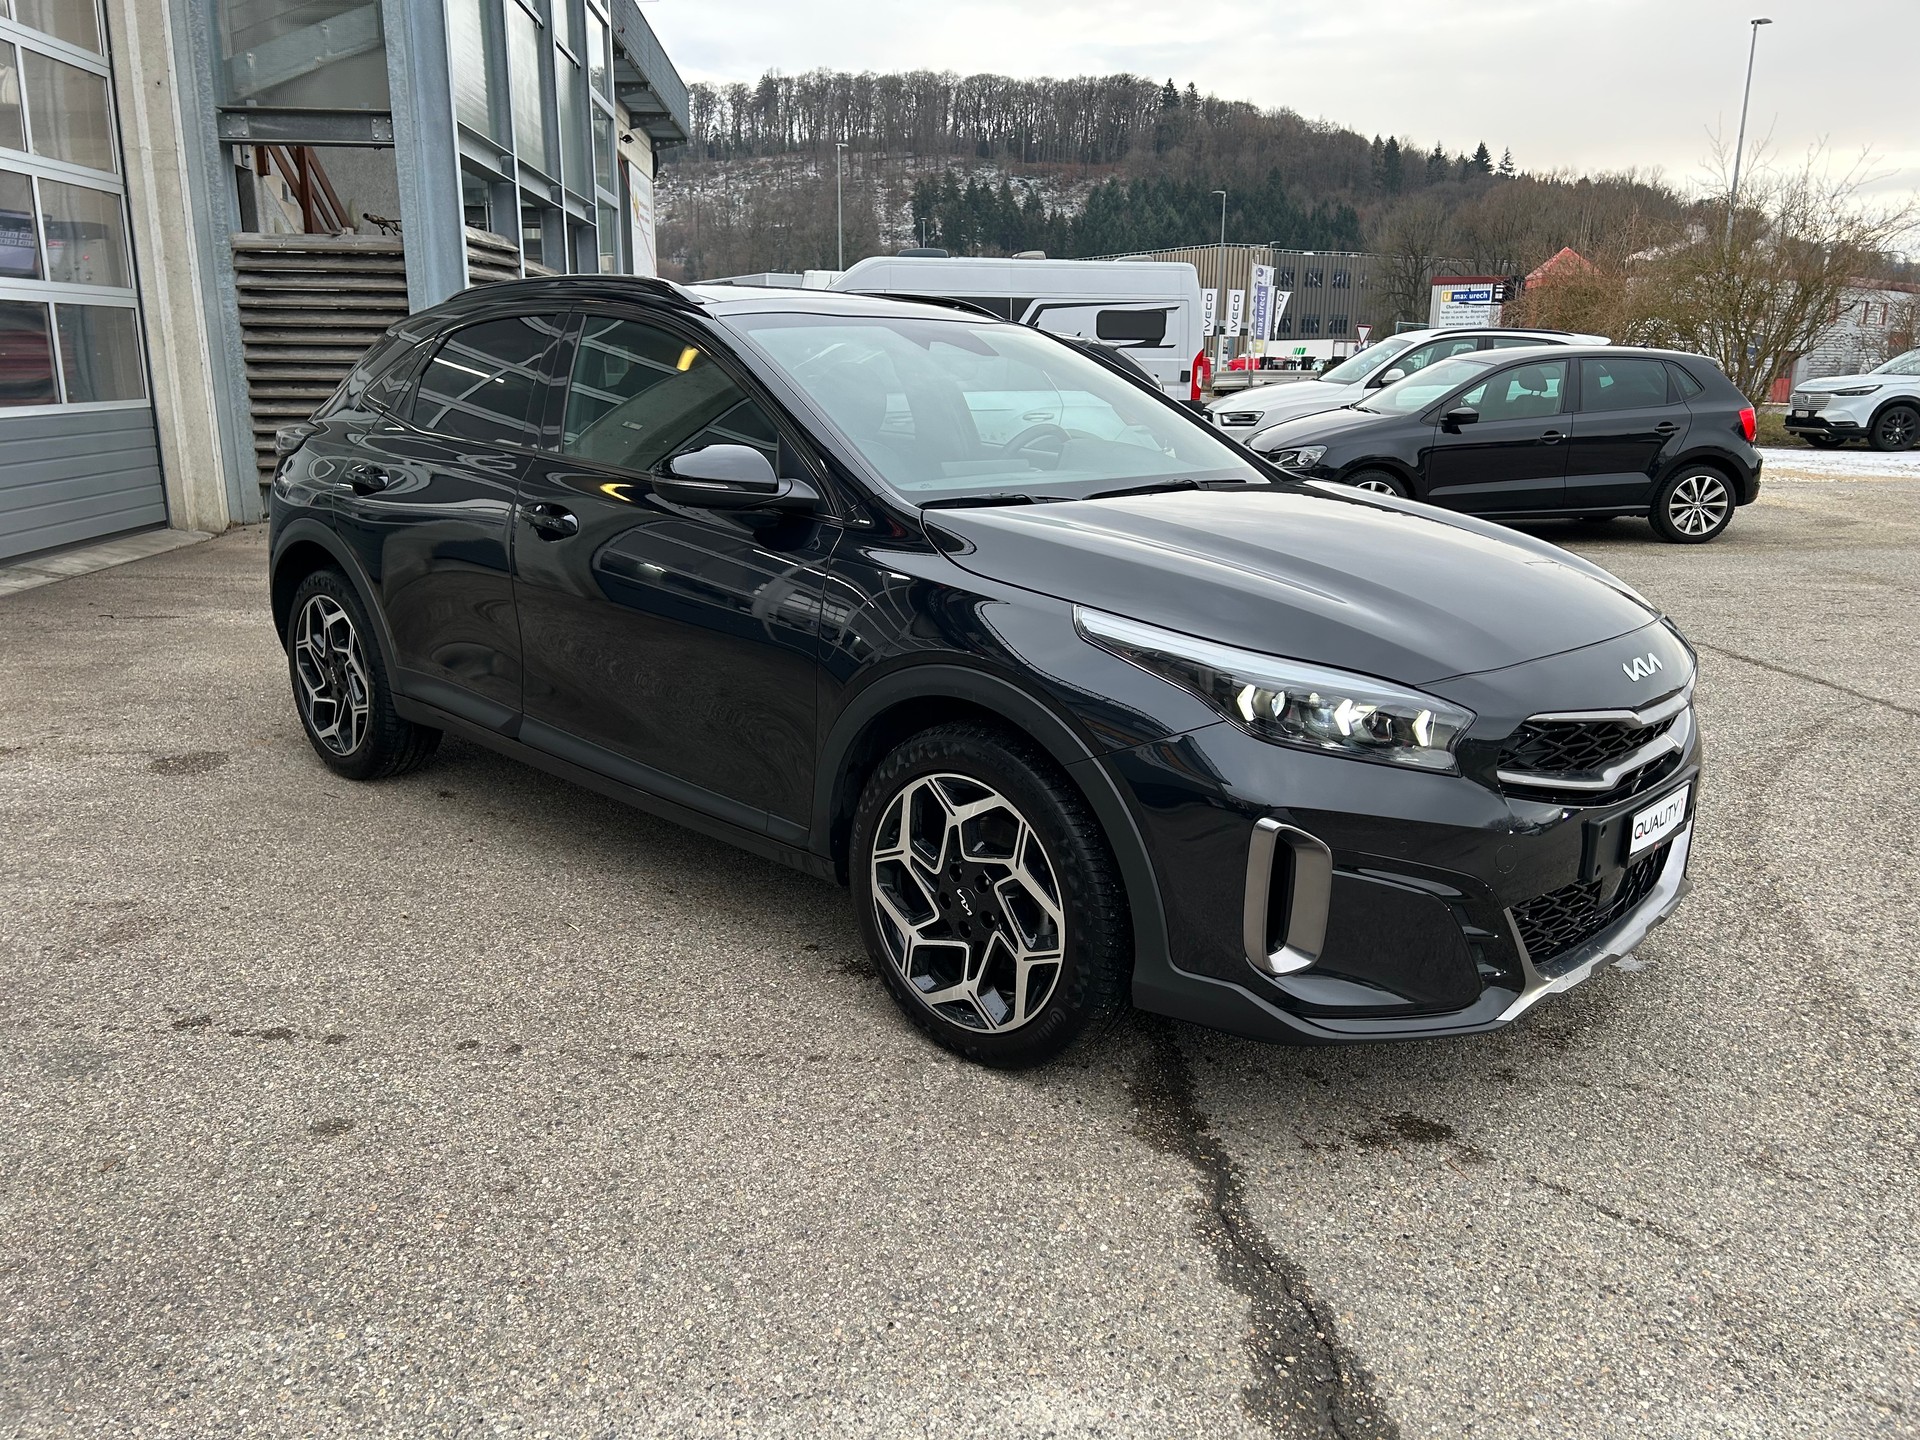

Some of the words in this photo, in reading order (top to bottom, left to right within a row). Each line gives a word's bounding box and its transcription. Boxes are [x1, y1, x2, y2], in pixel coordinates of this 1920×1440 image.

[1204, 293, 1213, 331] IVECO
[1231, 295, 1240, 332] IVECO
[1258, 291, 1266, 315] urech
[1622, 652, 1663, 682] KIA
[1634, 800, 1680, 840] QUALITY
